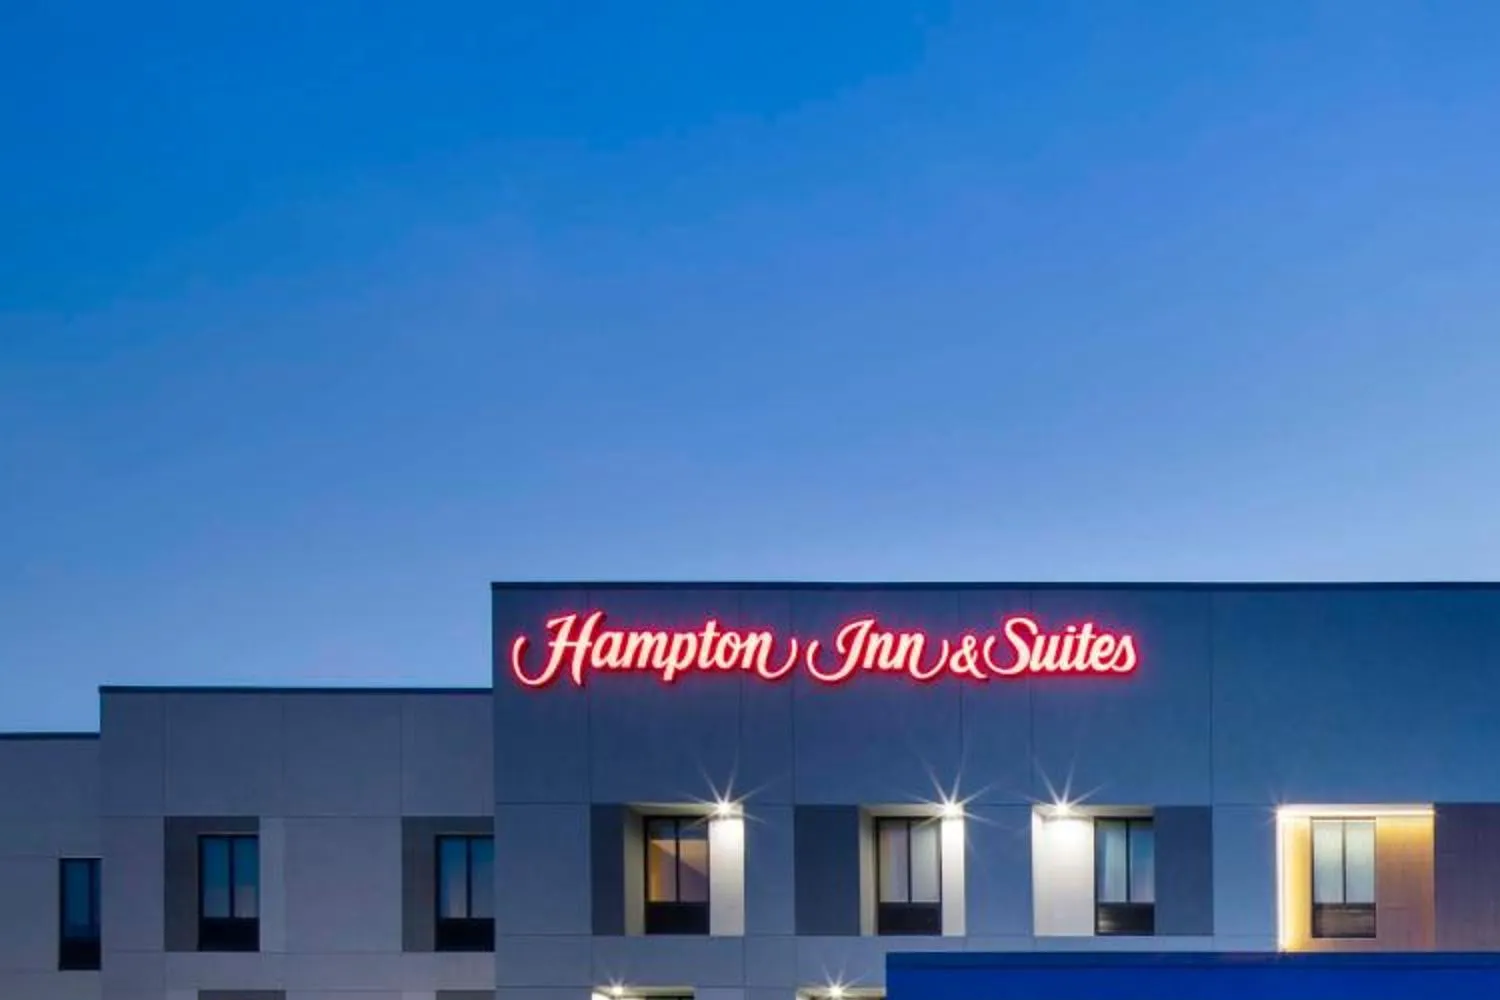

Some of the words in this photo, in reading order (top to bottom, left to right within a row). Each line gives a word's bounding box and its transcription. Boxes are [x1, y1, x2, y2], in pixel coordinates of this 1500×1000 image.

[512, 611, 798, 685] Hampton
[806, 619, 949, 682] Inn
[982, 617, 1137, 676] Suites
